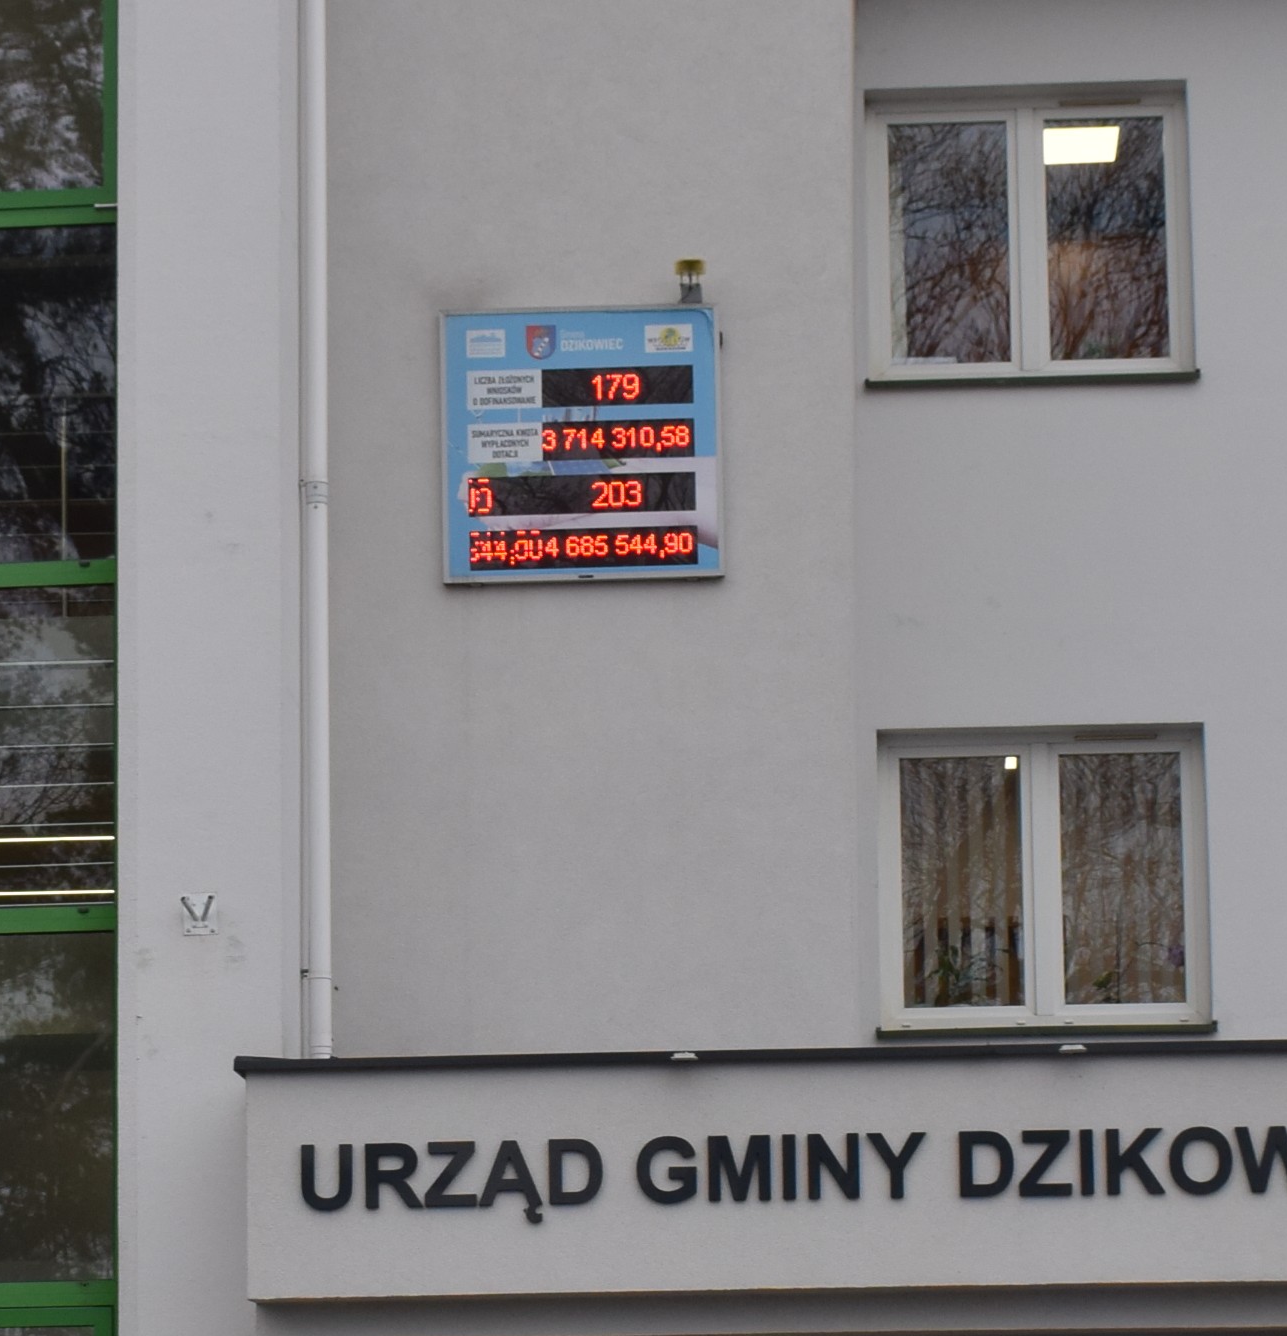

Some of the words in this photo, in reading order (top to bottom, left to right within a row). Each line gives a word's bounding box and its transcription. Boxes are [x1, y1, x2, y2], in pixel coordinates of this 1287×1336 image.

[561, 337, 624, 352] DZIKOWIEC
[474, 376, 496, 385] LICZBA
[591, 373, 641, 401] 179
[562, 427, 605, 450] 714
[612, 425, 690, 451] 310,58
[591, 480, 642, 508] 203
[565, 534, 609, 557] 685
[615, 532, 693, 559] 544,90
[300, 1139, 604, 1225] URZĄD
[635, 1132, 926, 1206] GMINY
